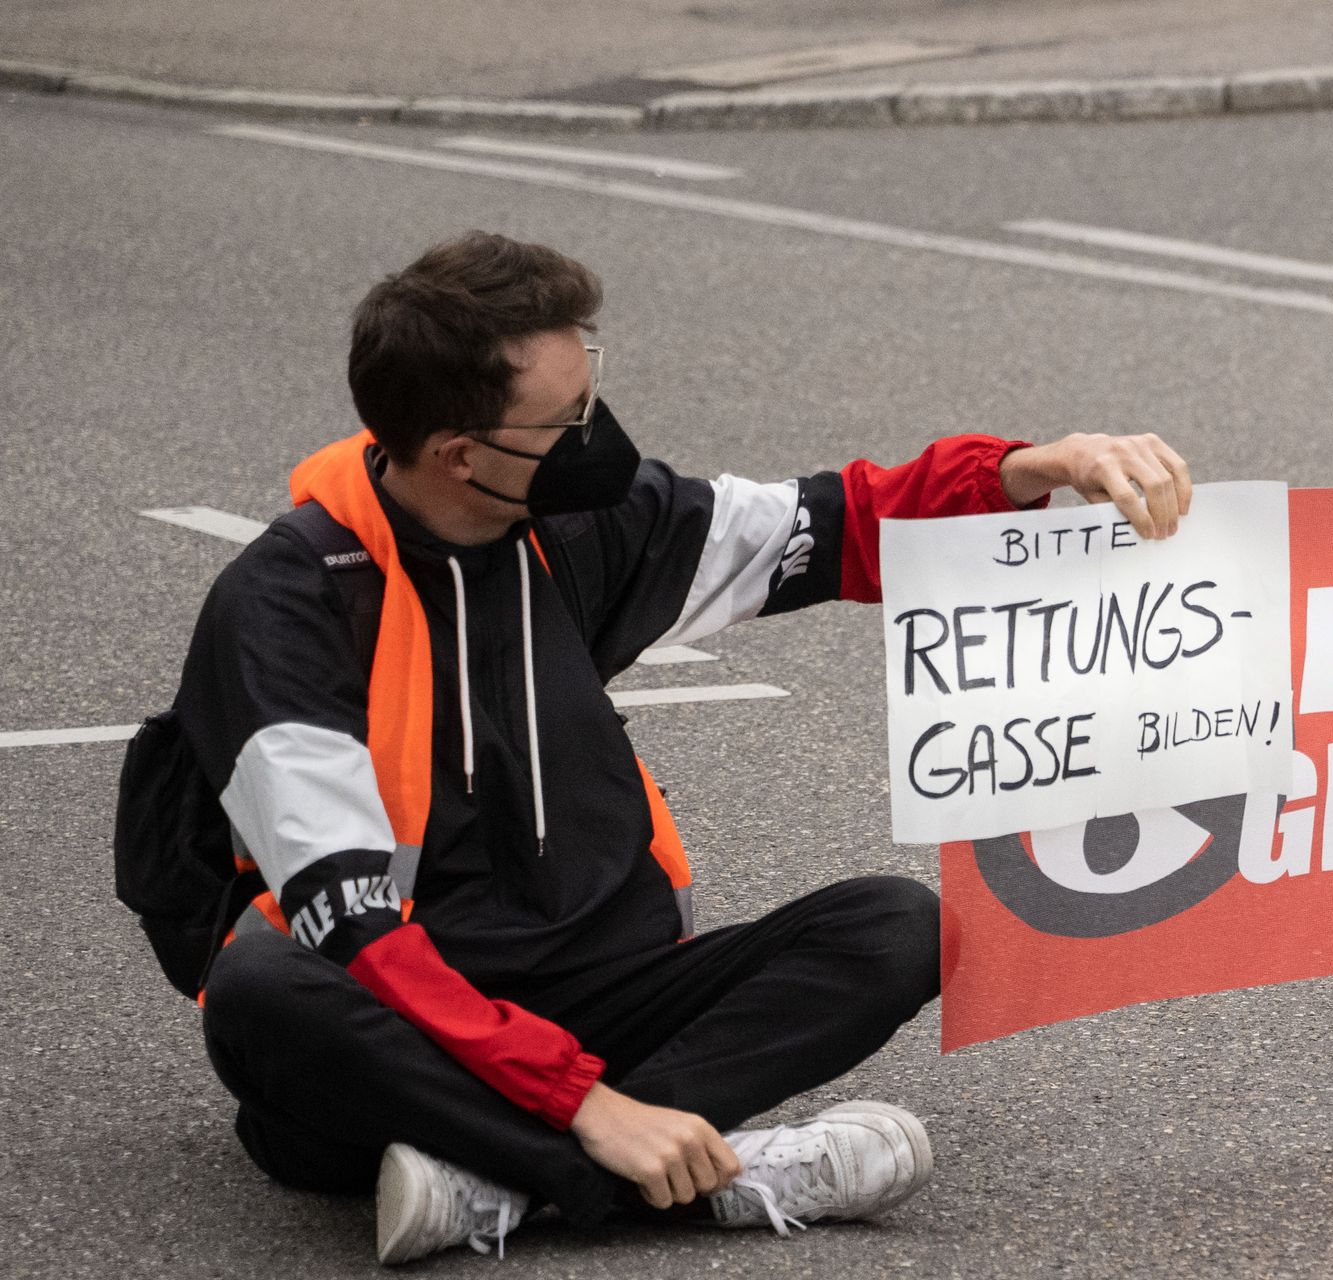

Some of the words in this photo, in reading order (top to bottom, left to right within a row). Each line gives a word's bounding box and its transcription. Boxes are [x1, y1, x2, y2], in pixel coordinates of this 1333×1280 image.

[993, 520, 1137, 566] BITTE
[894, 581, 1252, 696] RETTUNGS-
[908, 712, 1100, 798] GASSE
[1137, 700, 1281, 760] BILDEN!
